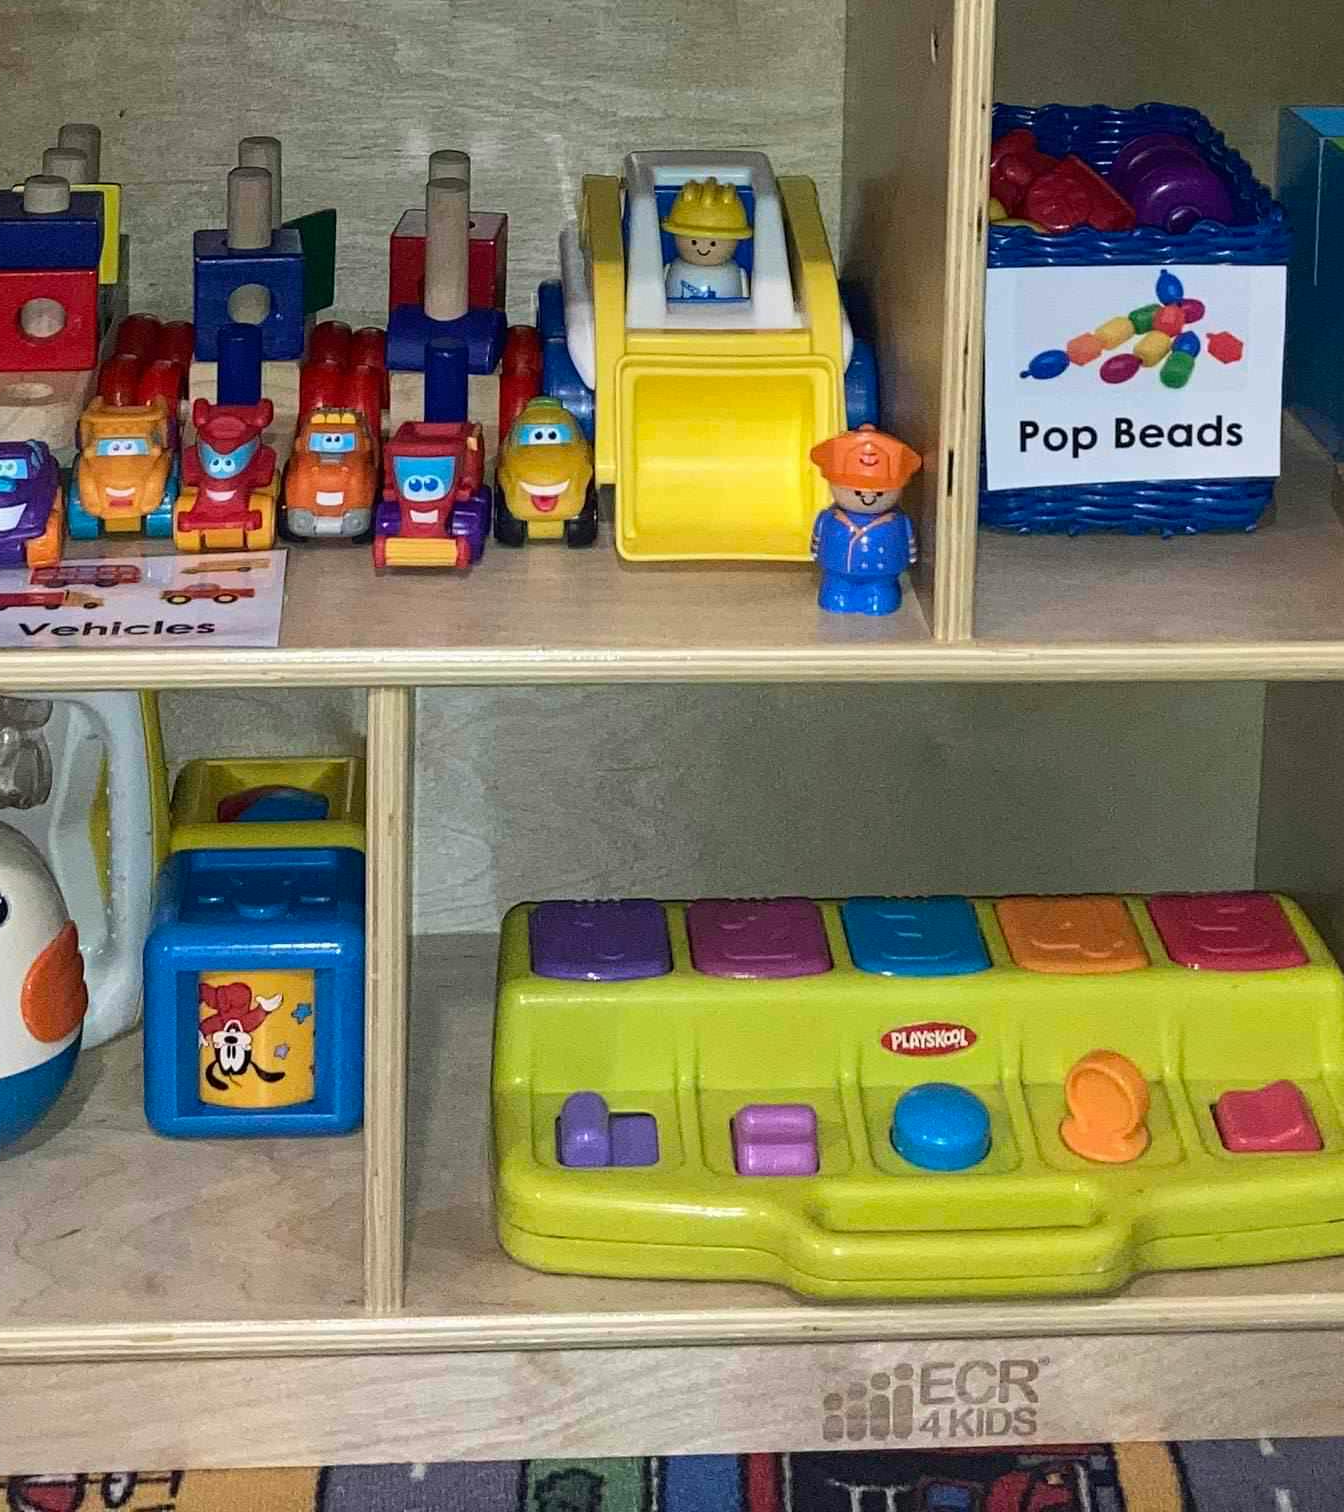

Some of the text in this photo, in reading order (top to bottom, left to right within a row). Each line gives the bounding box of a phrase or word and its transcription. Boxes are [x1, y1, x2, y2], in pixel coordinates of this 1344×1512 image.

[1019, 415, 1244, 459] Pop Beads
[18, 620, 216, 638] Vehicles
[890, 1028, 969, 1051] PLAYSKOOL
[920, 1359, 1040, 1405] ECR
